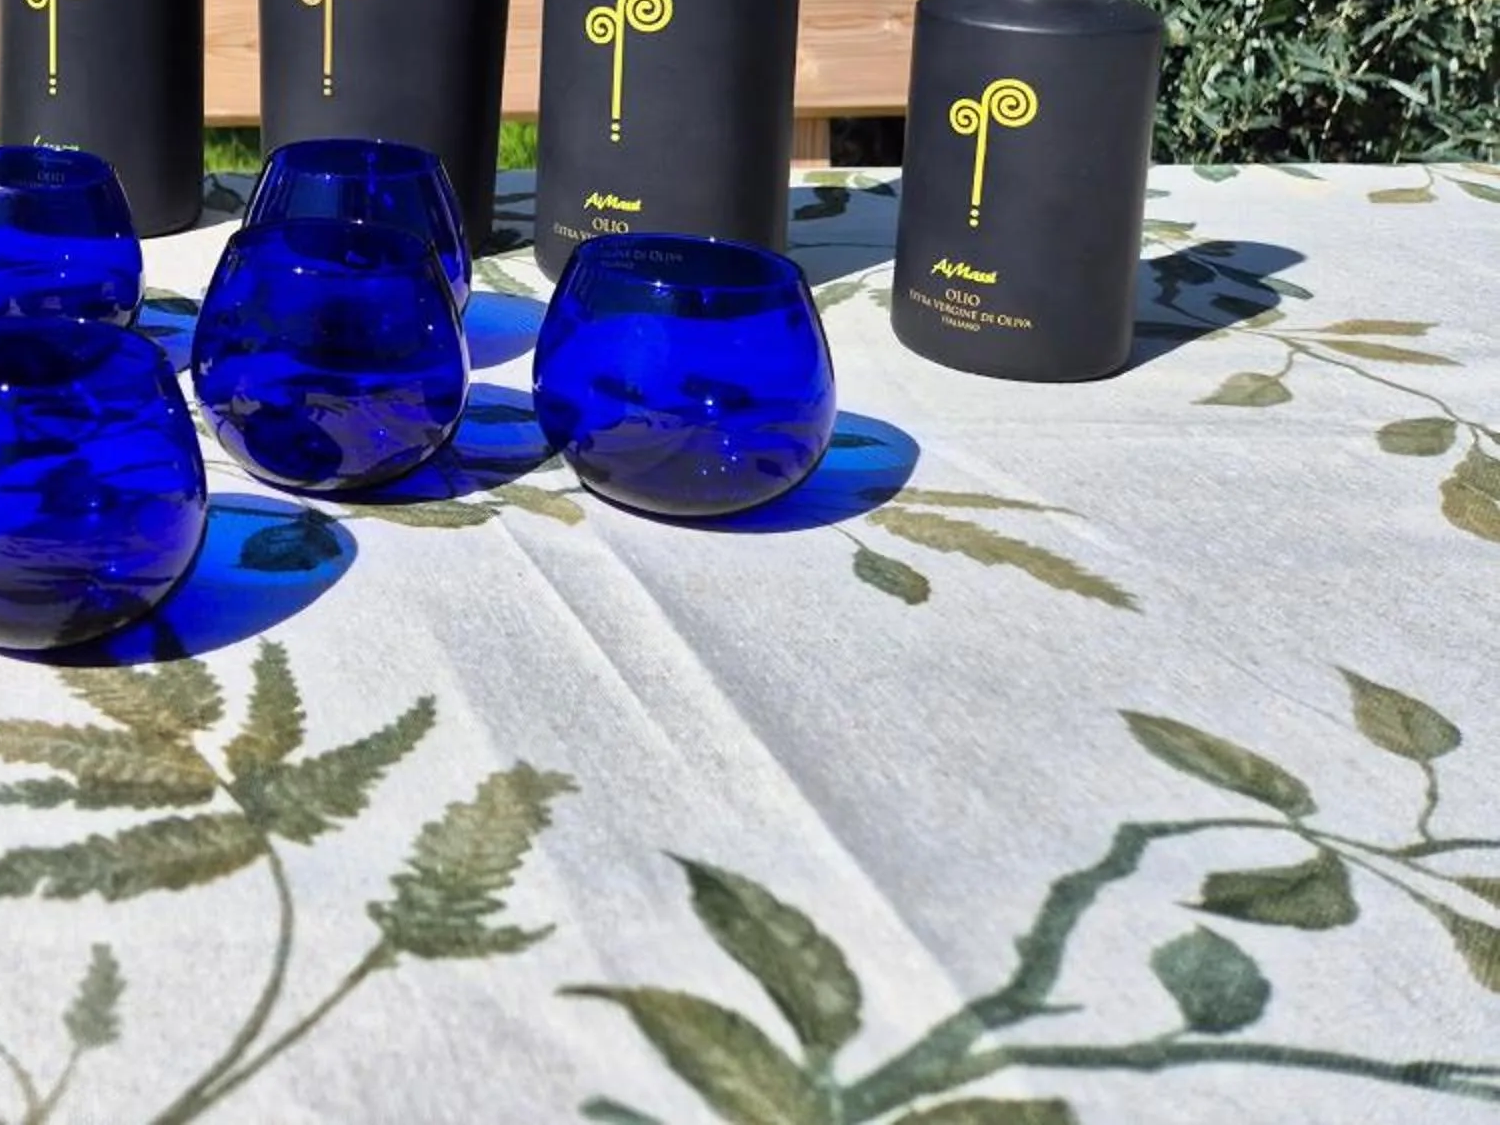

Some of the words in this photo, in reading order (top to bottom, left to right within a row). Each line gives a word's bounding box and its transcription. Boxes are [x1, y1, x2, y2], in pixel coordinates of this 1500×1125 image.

[591, 216, 629, 234] OLIO
[944, 288, 981, 307] OLIO
[980, 311, 995, 324] DI
[996, 314, 1033, 330] OLIVA
